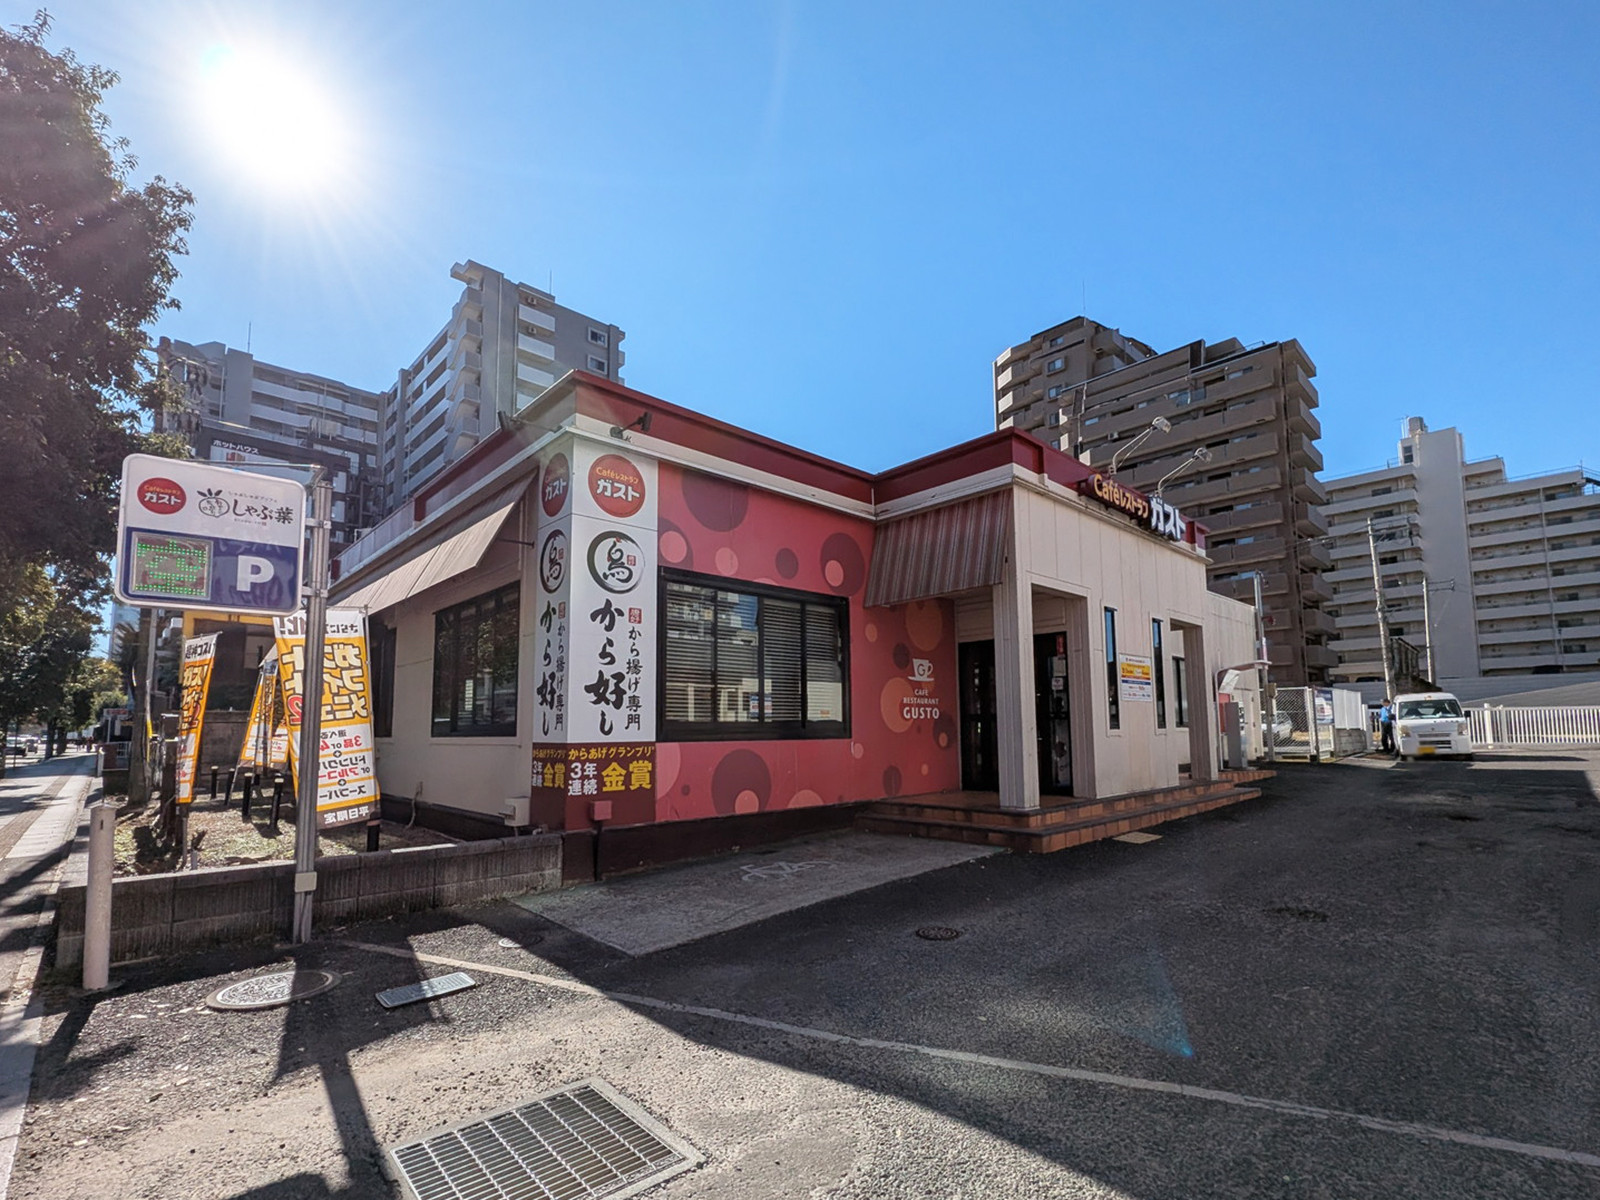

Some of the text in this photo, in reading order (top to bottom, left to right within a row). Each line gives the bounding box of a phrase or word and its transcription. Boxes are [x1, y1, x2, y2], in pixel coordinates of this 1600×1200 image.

[213, 440, 259, 454] ホットハウス
[144, 492, 181, 505] ガスト
[545, 478, 567, 502] ガスト
[597, 479, 640, 501] ガスト
[232, 499, 294, 524] しゃぶ葉
[1150, 495, 1187, 540] ガスト
[236, 554, 275, 592] P
[536, 600, 556, 736] から好し
[584, 598, 627, 736] から好し
[625, 626, 643, 731] から揚げ専門
[903, 697, 939, 705] RESTAURANT
[903, 707, 940, 719] GUSTO
[567, 746, 654, 760] からあげグランプリ
[543, 763, 566, 789] 金賞
[570, 762, 598, 778] 3年
[601, 760, 653, 792] 金賞
[568, 778, 598, 796] 連続
